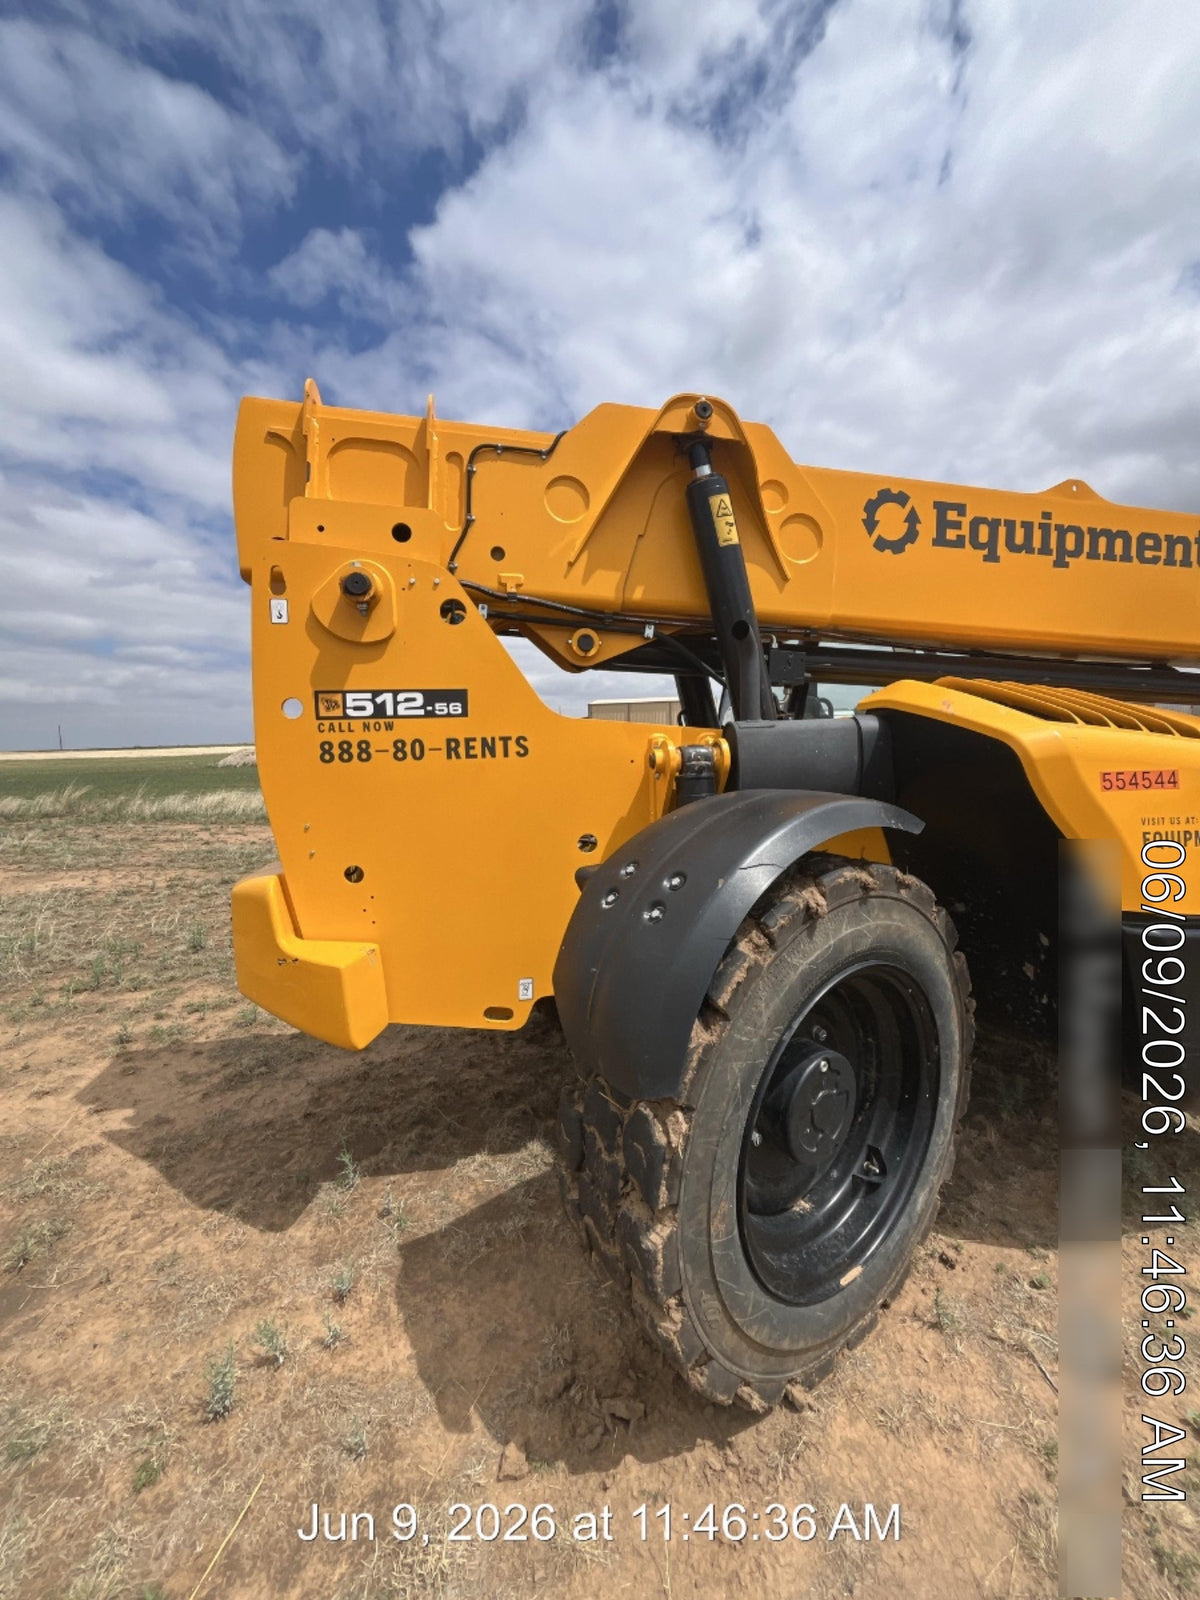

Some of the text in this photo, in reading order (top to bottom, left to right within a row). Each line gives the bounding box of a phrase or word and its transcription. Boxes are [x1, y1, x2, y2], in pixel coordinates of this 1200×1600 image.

[931, 500, 1200, 569] Equipmen
[345, 692, 463, 717] 512-56
[317, 721, 395, 733] CALL NOW
[319, 735, 530, 764] 888-80-RENTS
[1102, 771, 1178, 791] 554544
[1141, 816, 1165, 826] VISIT
[1170, 816, 1181, 825] US
